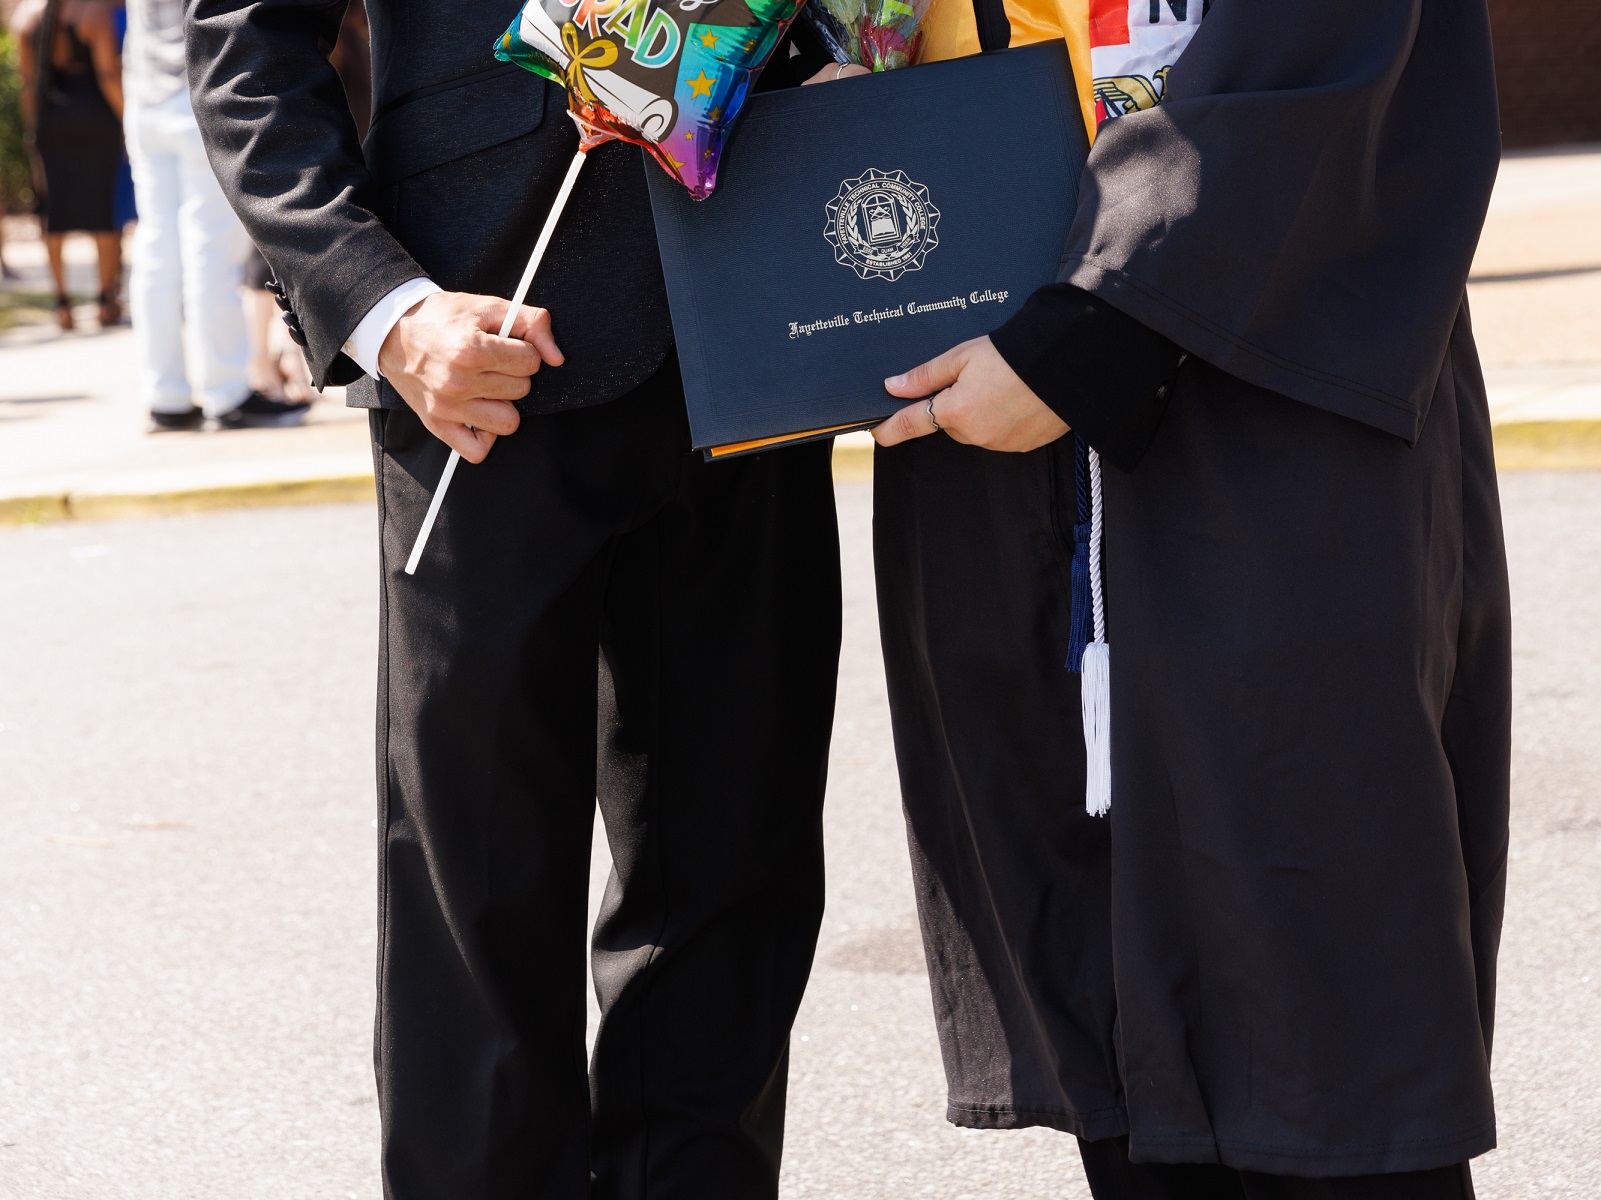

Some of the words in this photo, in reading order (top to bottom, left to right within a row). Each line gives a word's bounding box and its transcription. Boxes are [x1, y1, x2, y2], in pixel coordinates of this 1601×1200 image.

[839, 202, 850, 244] FAYETTEVILLE
[849, 183, 880, 202] TECHNICAL
[881, 182, 916, 202] COMMUNITY
[914, 201, 926, 230] COLLEGE
[788, 314, 850, 339] Fayetteville
[852, 305, 904, 324] Technical
[907, 297, 967, 315] Community
[969, 289, 1009, 304] College
